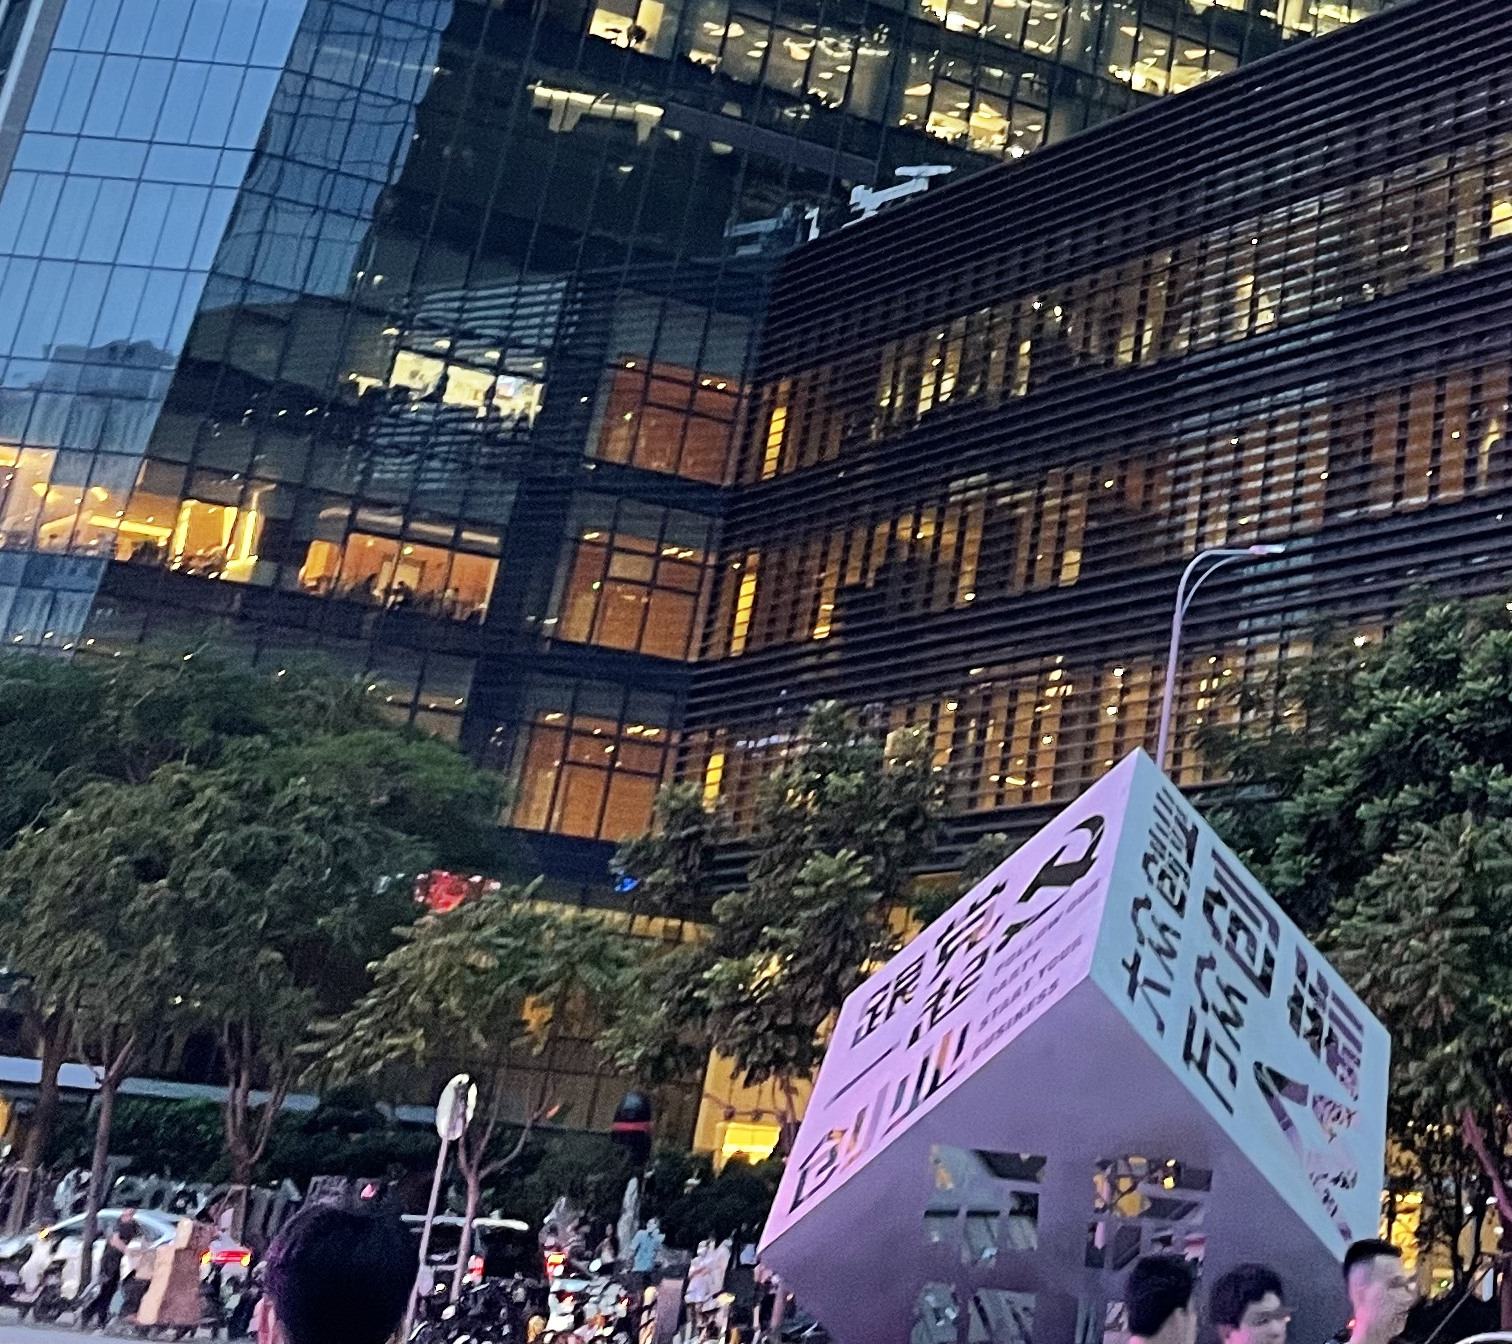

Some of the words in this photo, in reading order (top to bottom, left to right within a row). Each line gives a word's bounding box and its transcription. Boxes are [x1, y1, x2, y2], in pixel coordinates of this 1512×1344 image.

[986, 948, 1040, 1003] PARTY
[970, 976, 1059, 1062] BUSINESS
[978, 977, 1031, 1032] START
